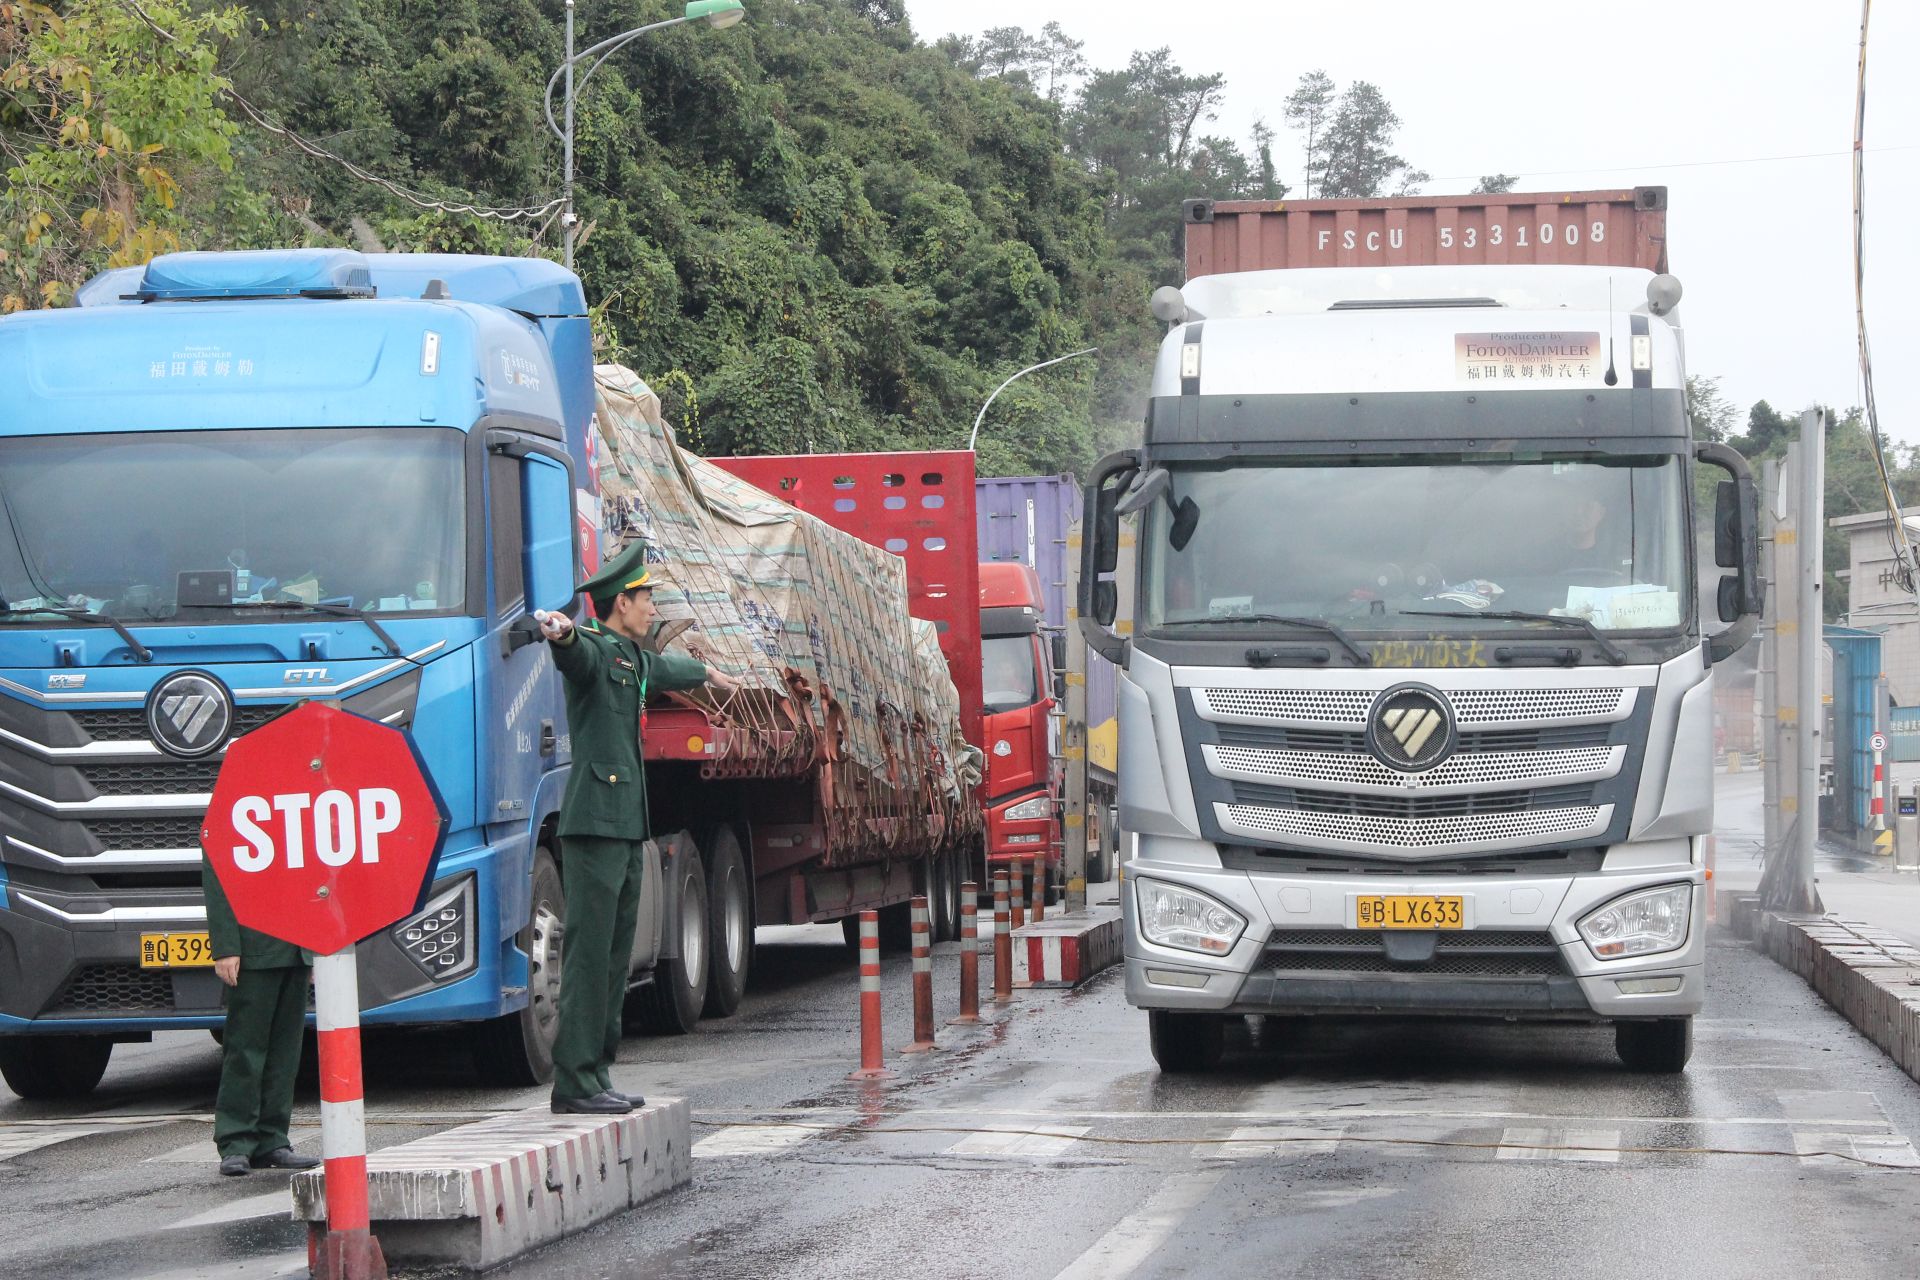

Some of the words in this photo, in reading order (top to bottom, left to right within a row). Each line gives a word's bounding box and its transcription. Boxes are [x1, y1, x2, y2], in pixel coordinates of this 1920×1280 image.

[1318, 229, 1403, 251] FSCU
[1440, 222, 1605, 248] 5331008
[150, 360, 254, 378] 福田戴姆勒
[1467, 364, 1591, 380] 福田戴姆勒汽车
[284, 668, 335, 683] GTL
[1875, 738, 1883, 748] 5
[231, 787, 402, 873] STOP
